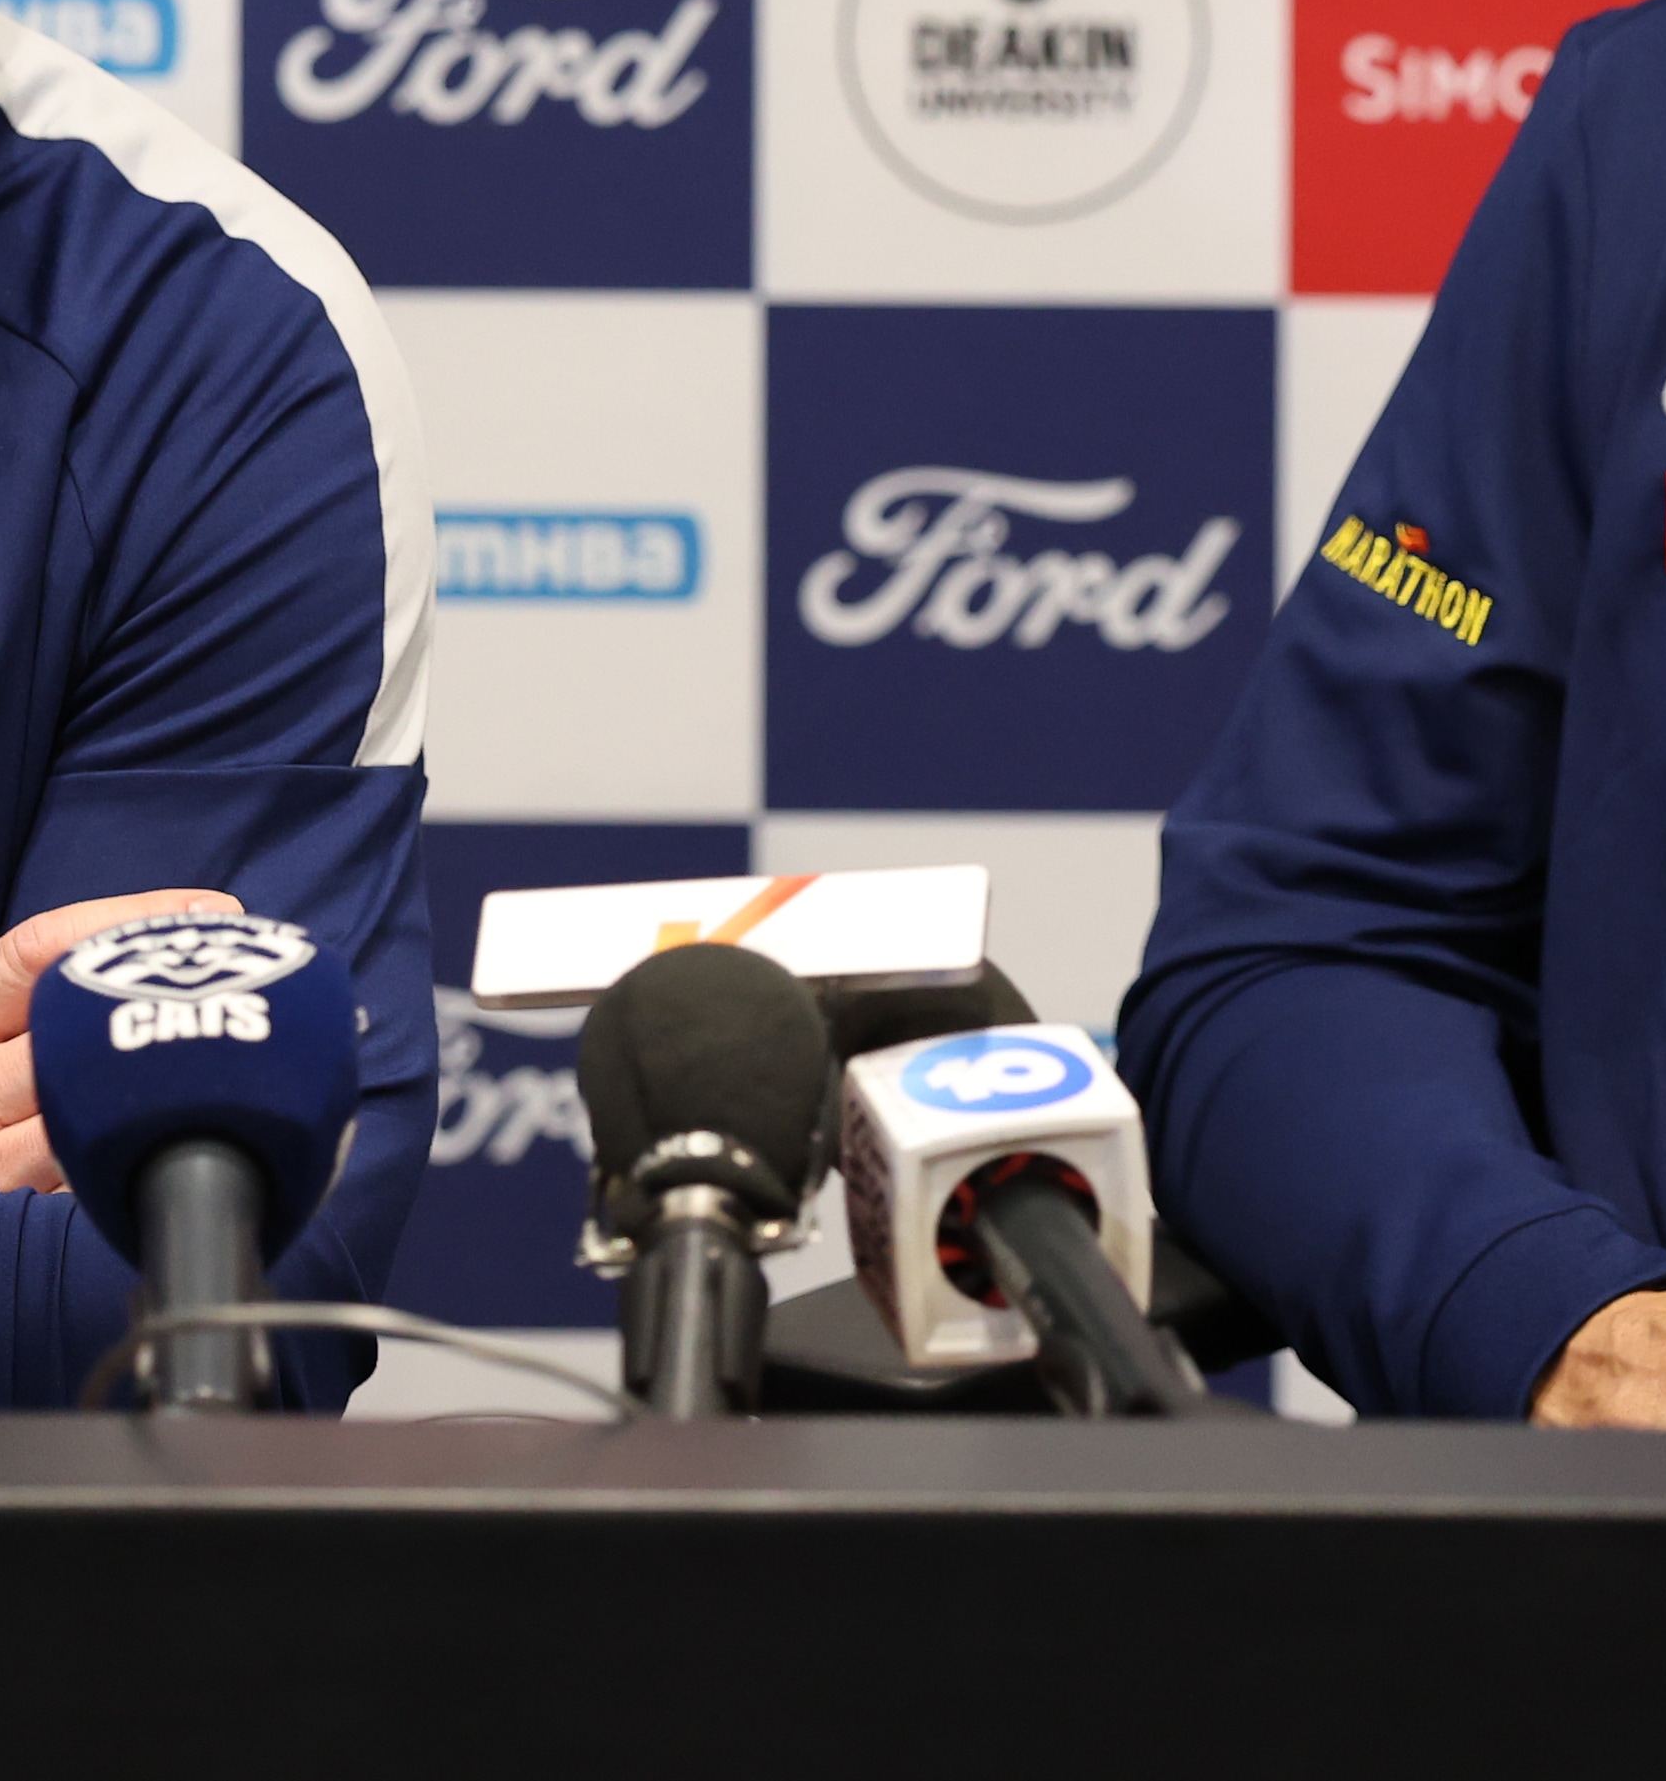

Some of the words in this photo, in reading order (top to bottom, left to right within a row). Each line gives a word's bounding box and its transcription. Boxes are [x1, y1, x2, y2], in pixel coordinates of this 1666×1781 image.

[911, 20, 1136, 73] DEAKIN
[1341, 33, 1556, 123] SIMO
[910, 87, 1134, 119] UNIVERSITY
[799, 466, 1237, 651] Ford
[1320, 514, 1494, 647] MARATHON
[109, 991, 271, 1052] CATS
